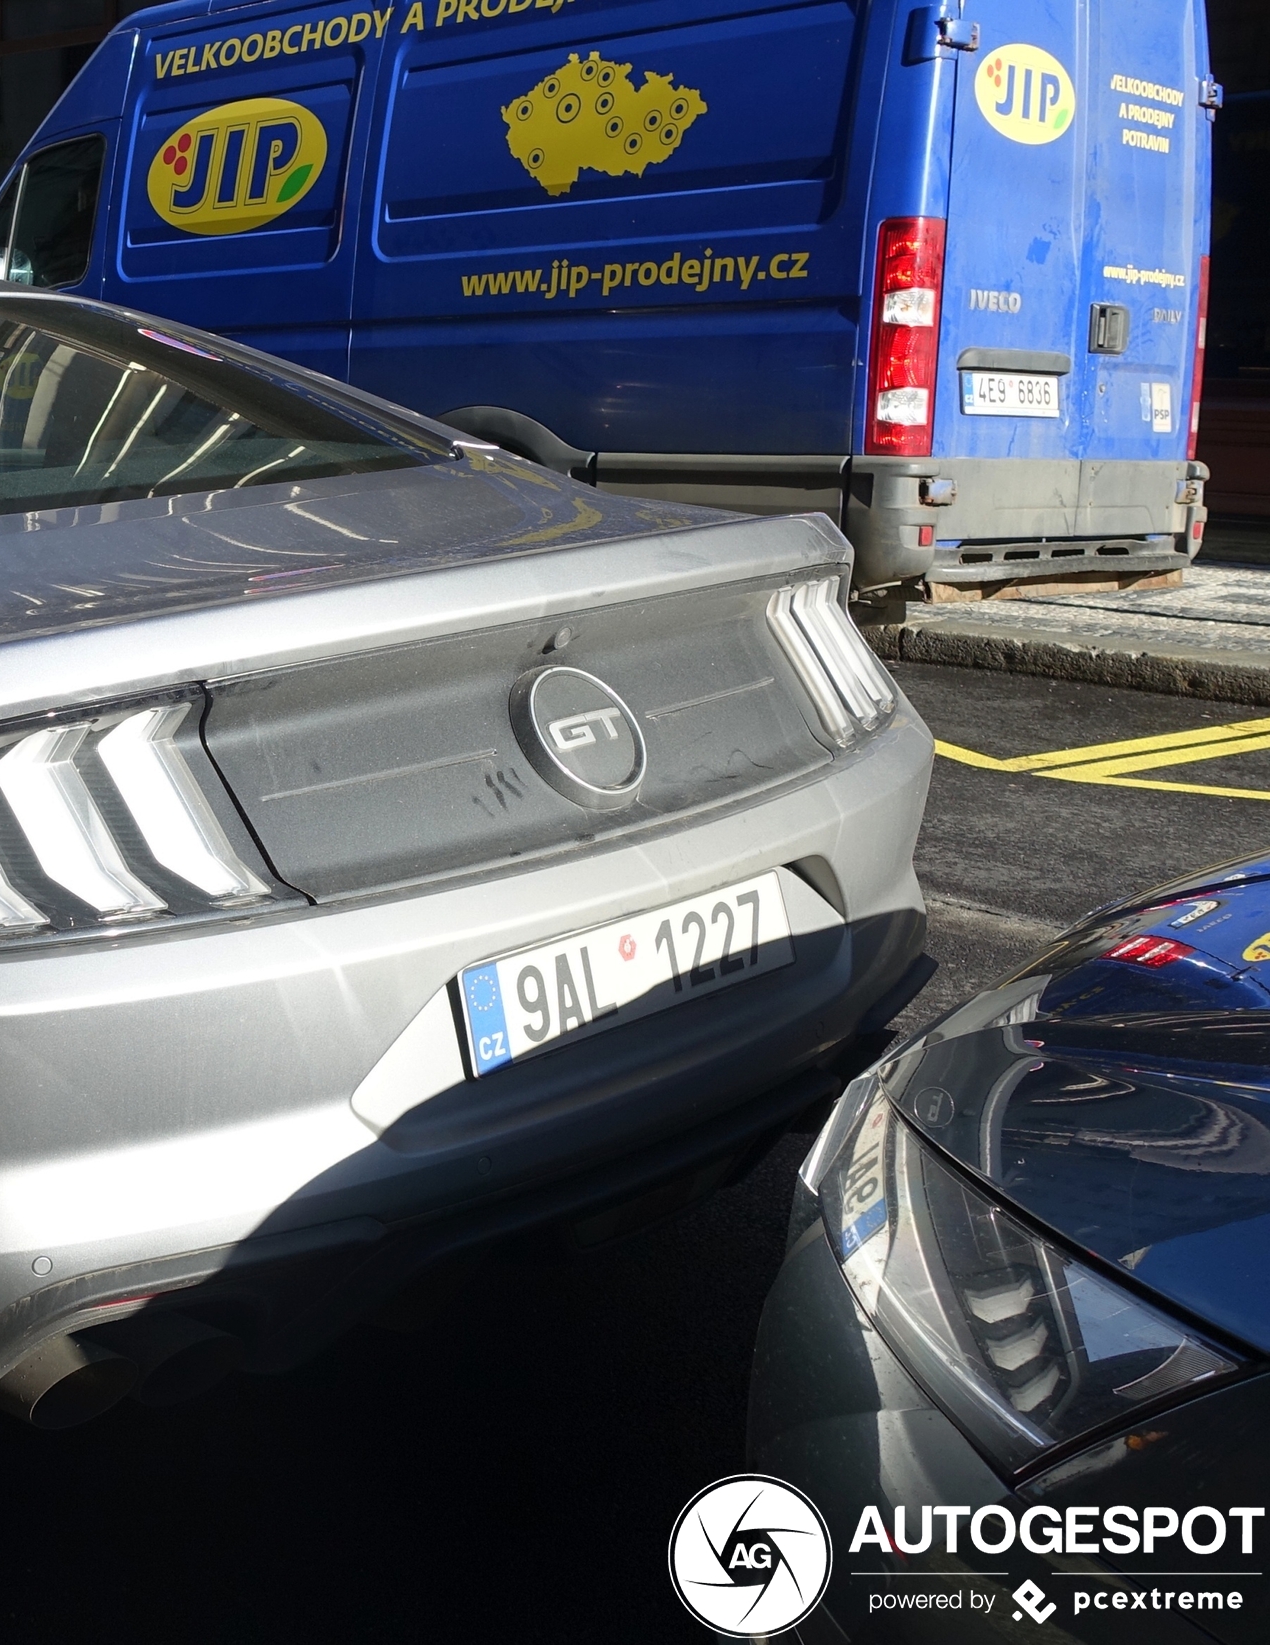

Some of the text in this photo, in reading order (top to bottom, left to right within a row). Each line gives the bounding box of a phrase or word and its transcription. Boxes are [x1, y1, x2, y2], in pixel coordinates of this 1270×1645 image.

[155, 7, 395, 79] VELKOOBCHODY
[401, 1, 425, 33] A
[994, 63, 1061, 123] JIP
[1110, 74, 1184, 107] VELKOOBCHODY
[1119, 102, 1175, 129] A PRODEJNY
[1122, 129, 1169, 153] POTRAVIN
[168, 115, 304, 215] JIP
[461, 247, 810, 298] www.jip-prodejny.cz
[1103, 265, 1185, 288] www.jip-prodejny.cz
[969, 289, 1022, 313] IVECO
[978, 378, 1052, 406] 4E9 6836
[1154, 408, 1170, 421] PSP
[549, 707, 621, 752] GT
[516, 889, 760, 1043] 9AL 1227
[479, 1031, 507, 1061] CZ
